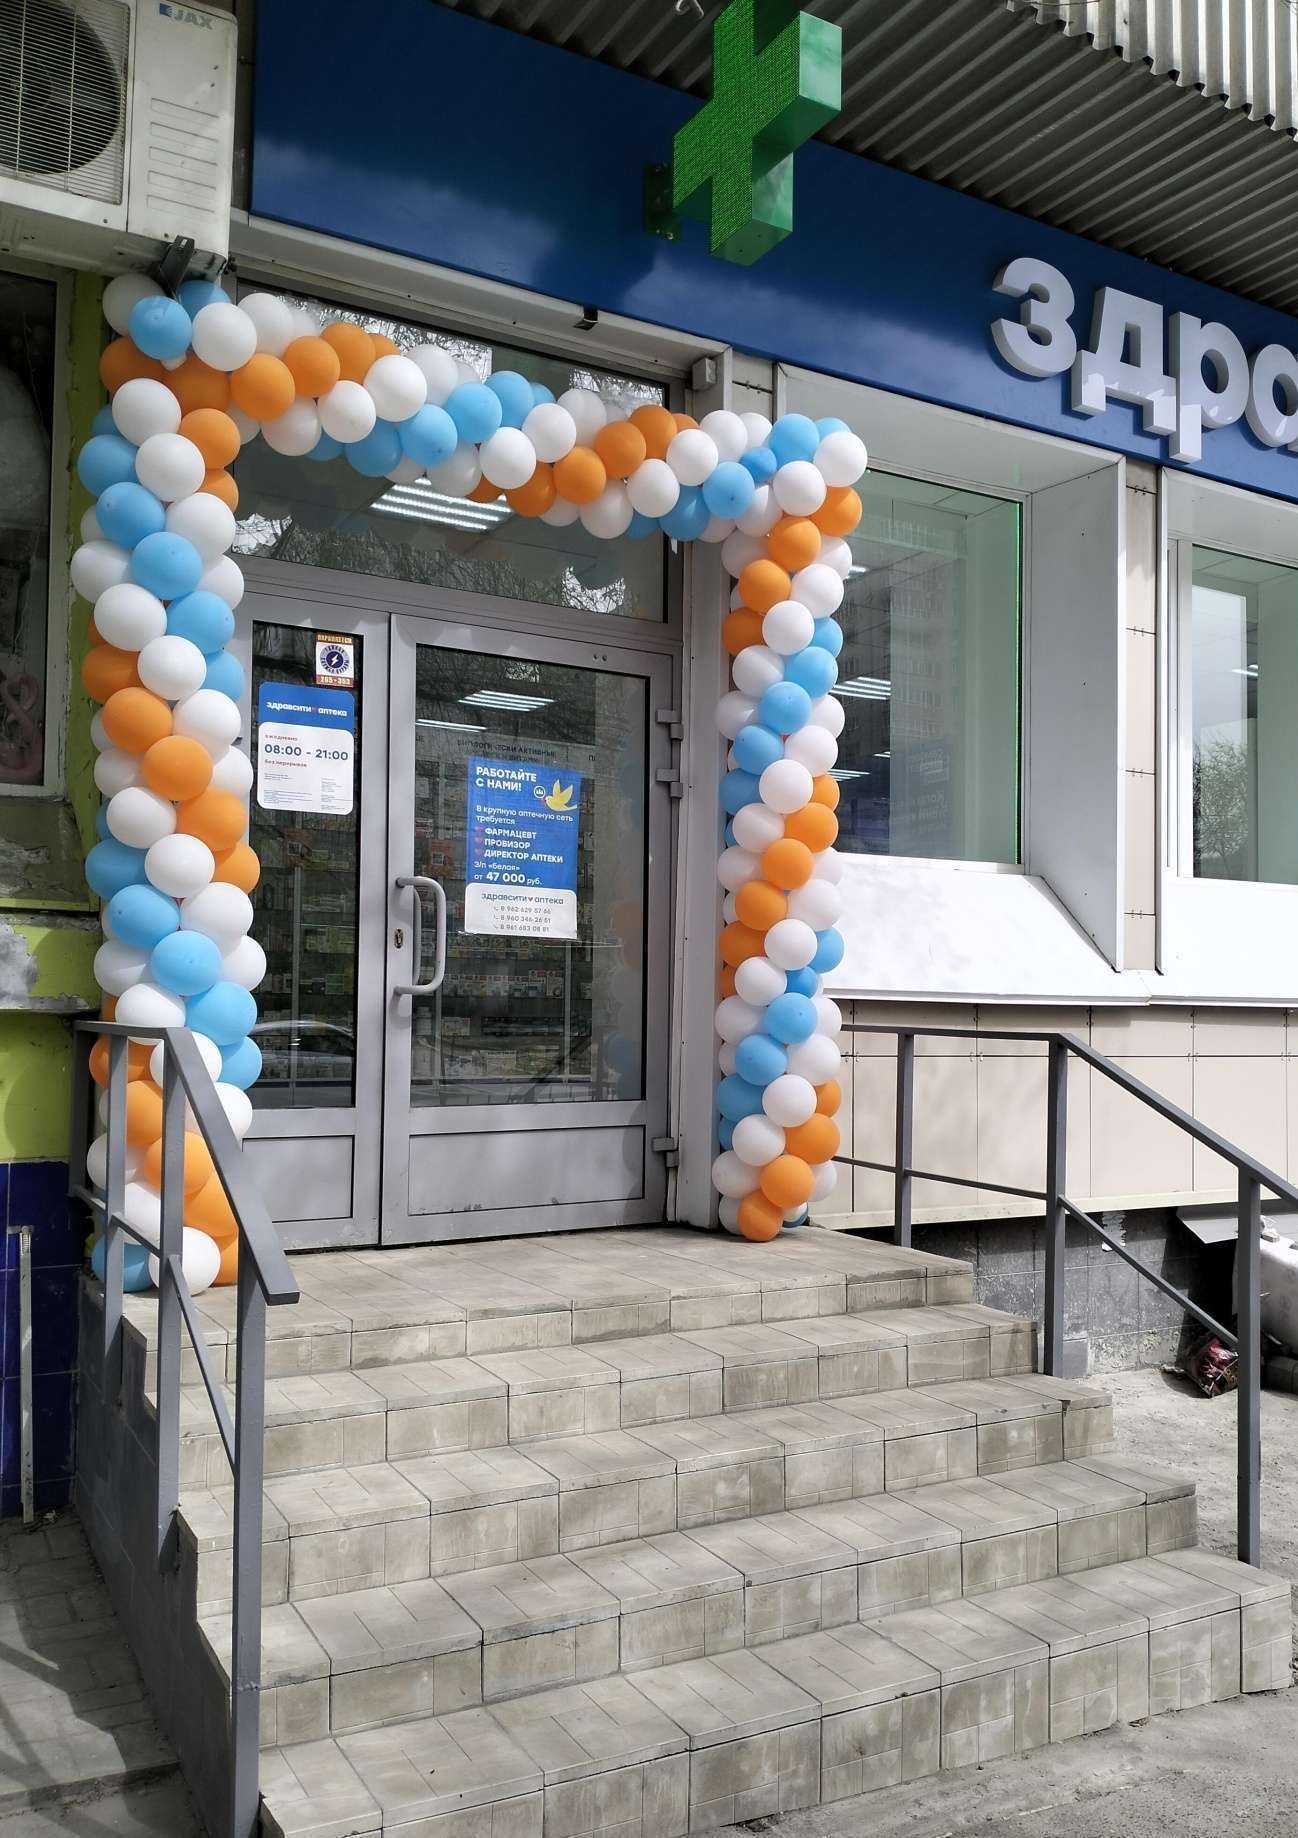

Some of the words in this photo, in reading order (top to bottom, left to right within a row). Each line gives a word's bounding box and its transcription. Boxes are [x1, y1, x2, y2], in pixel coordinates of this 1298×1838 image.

[174, 9, 213, 30] JAX
[266, 701, 311, 713] здравсити
[318, 706, 348, 717] аптека
[264, 743, 302, 757] 08:00
[315, 748, 348, 761] 21:00
[476, 766, 537, 783] РАБОТАЙТЕ
[476, 778, 484, 787] С
[487, 779, 522, 792] НАМИ!
[476, 815, 516, 825] требуется
[483, 806, 517, 817] крупную
[518, 810, 555, 821] аптечную
[556, 814, 574, 822] сеть
[484, 827, 537, 840] ФАРМАЦЕВТ
[484, 849, 529, 860] ДИРЕКТОР
[531, 854, 564, 864] АПТЕКИ
[486, 871, 500, 882] 47
[502, 873, 526, 883] 000
[527, 877, 542, 886] руб.
[481, 892, 527, 903] здравсити
[534, 897, 564, 905] аптека
